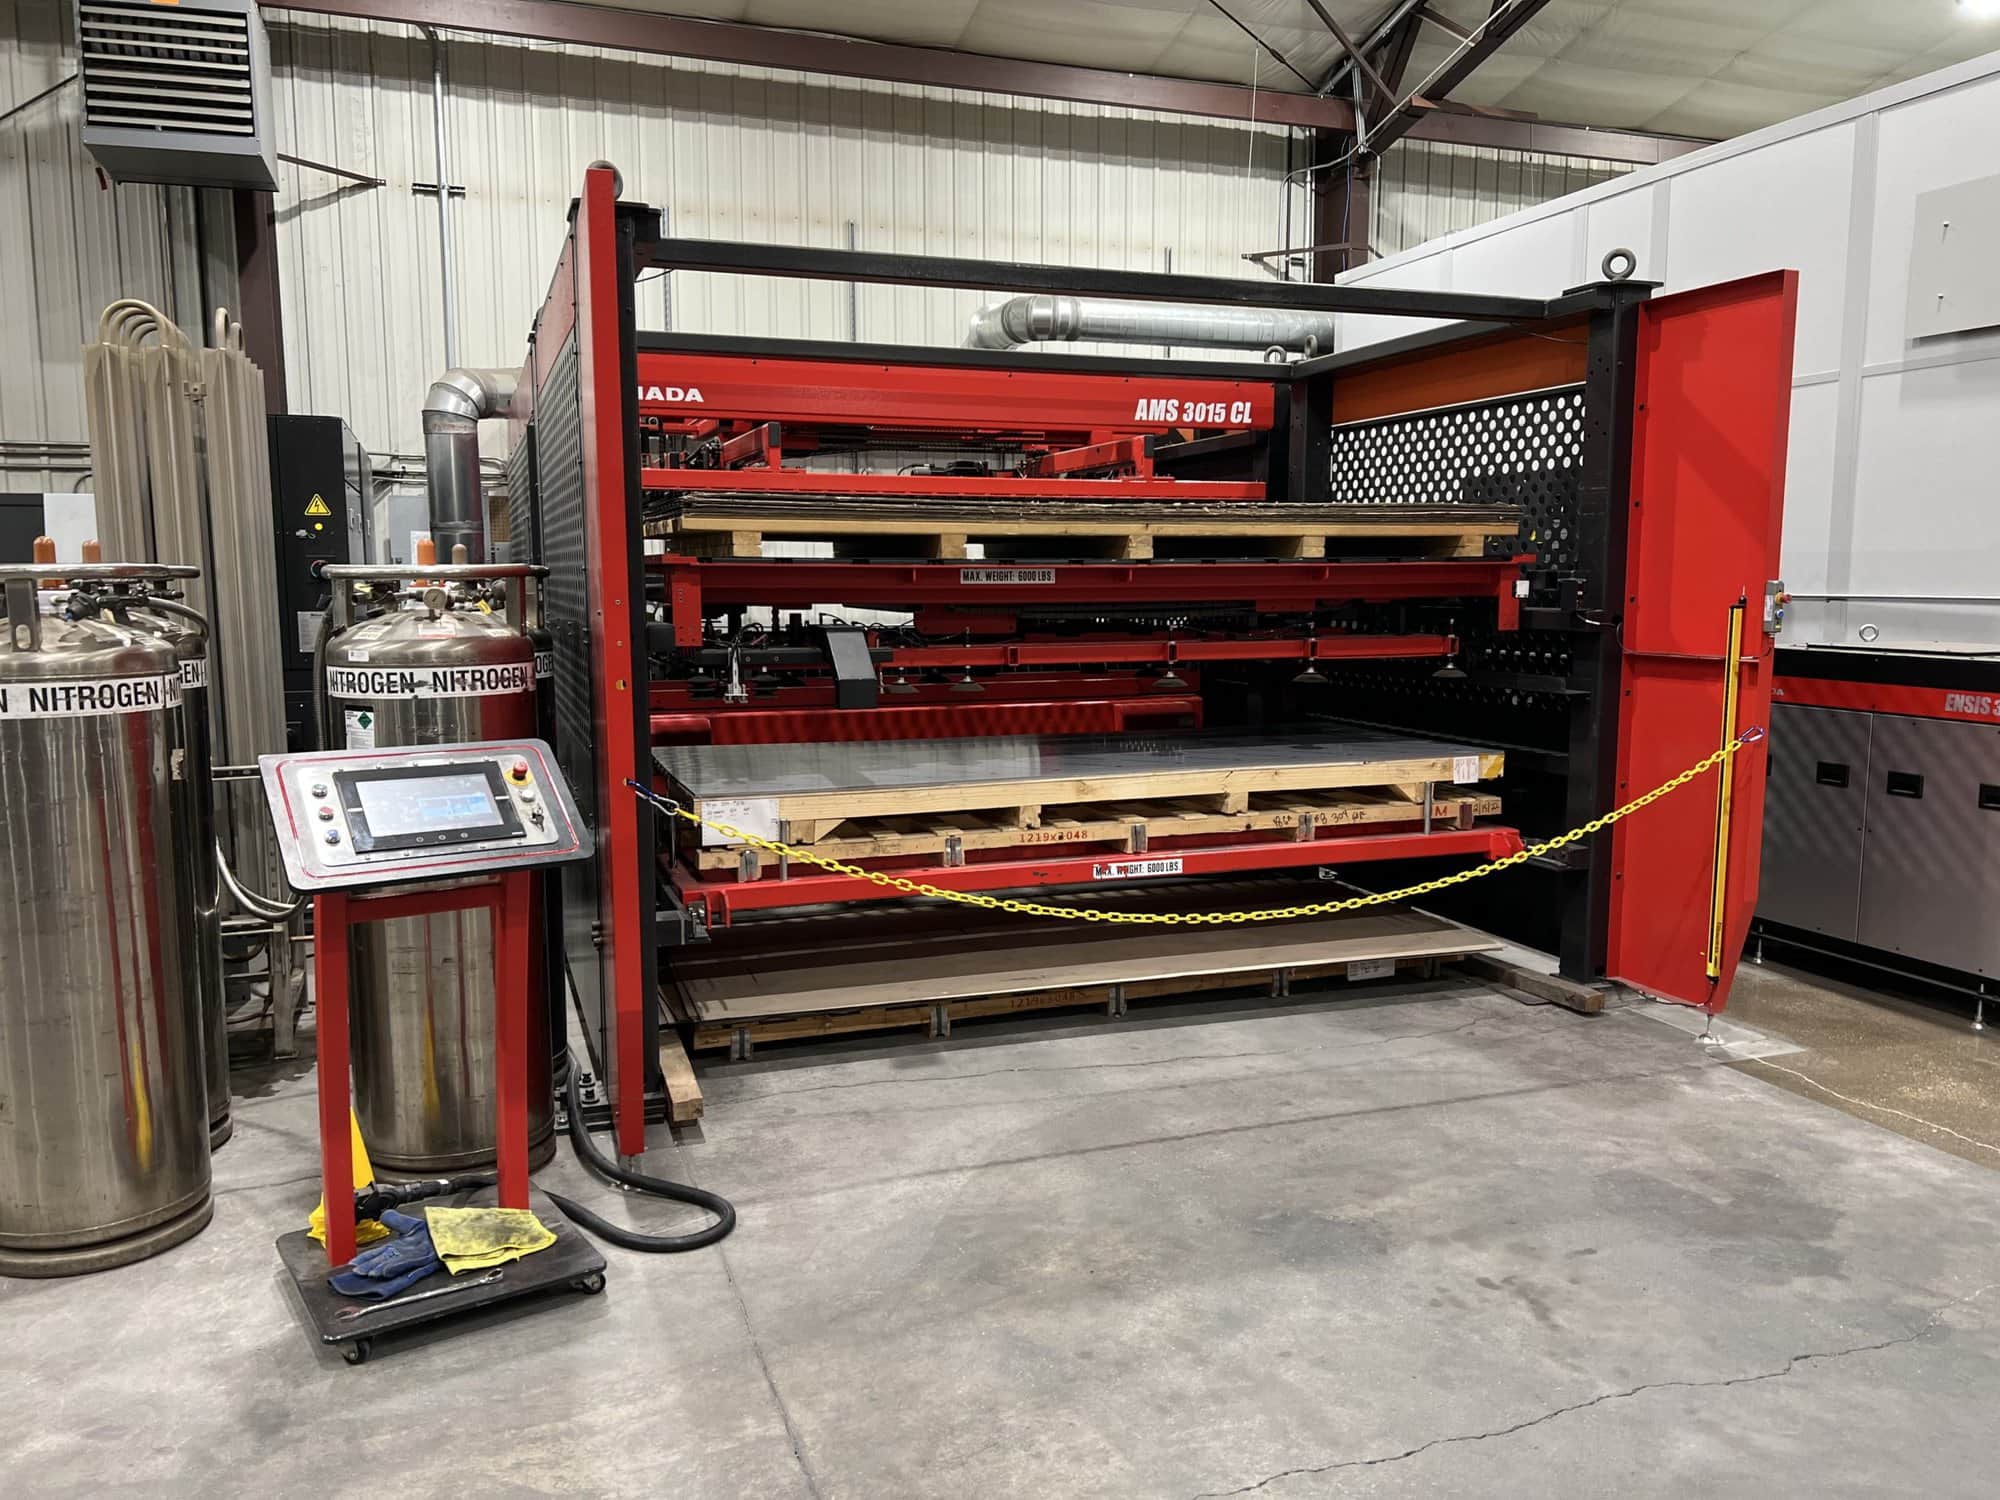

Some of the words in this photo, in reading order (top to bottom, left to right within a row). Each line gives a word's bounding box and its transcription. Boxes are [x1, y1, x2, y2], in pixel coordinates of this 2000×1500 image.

[1134, 398, 1179, 422] AMS
[1182, 402, 1226, 423] 3015
[1230, 401, 1252, 424] CL
[963, 570, 983, 582] MAX.
[985, 570, 1015, 582] WEIGHT:
[1018, 570, 1036, 582] 6000
[330, 670, 415, 694] NITROGEN
[433, 665, 528, 692] NITROGEN
[29, 680, 159, 712] NITROGEN
[1945, 693, 1991, 715] ENSIS
[1435, 805, 1448, 817] M
[1147, 862, 1164, 873] 6000
[1165, 860, 1182, 872] LBS.
